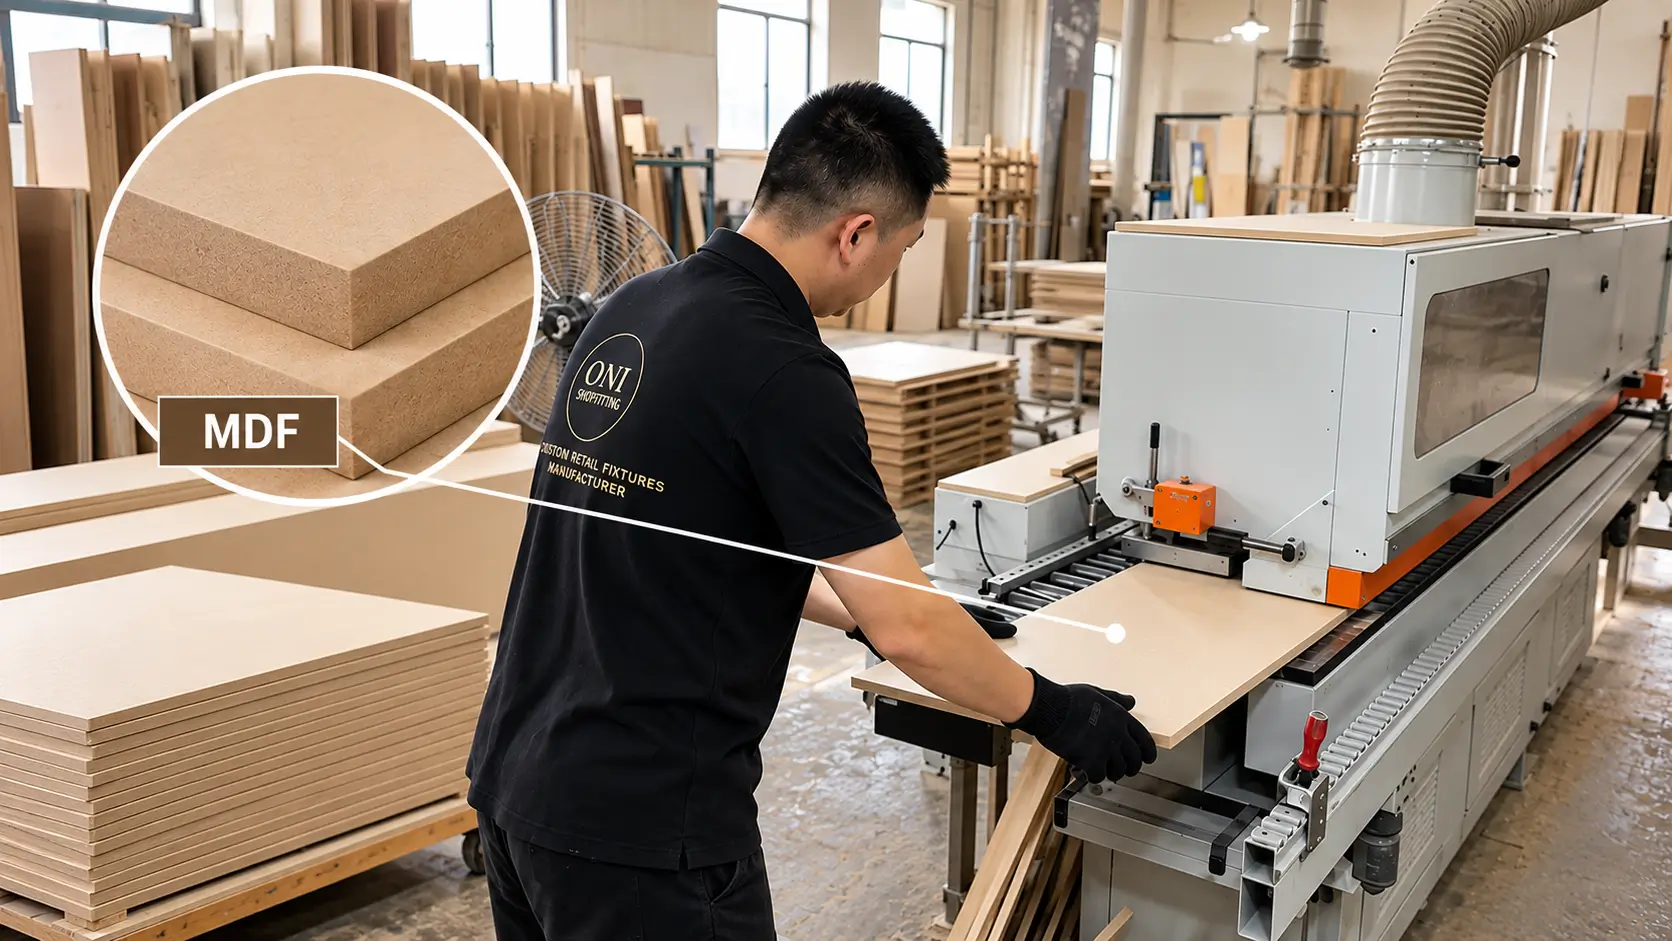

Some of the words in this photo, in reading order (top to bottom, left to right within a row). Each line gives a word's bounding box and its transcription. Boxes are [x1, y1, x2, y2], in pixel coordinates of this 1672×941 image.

[585, 360, 632, 393] ONI
[547, 461, 626, 498] MANUFACTURER
[570, 451, 599, 471] RETAIL
[602, 463, 665, 493] FIXTURES
